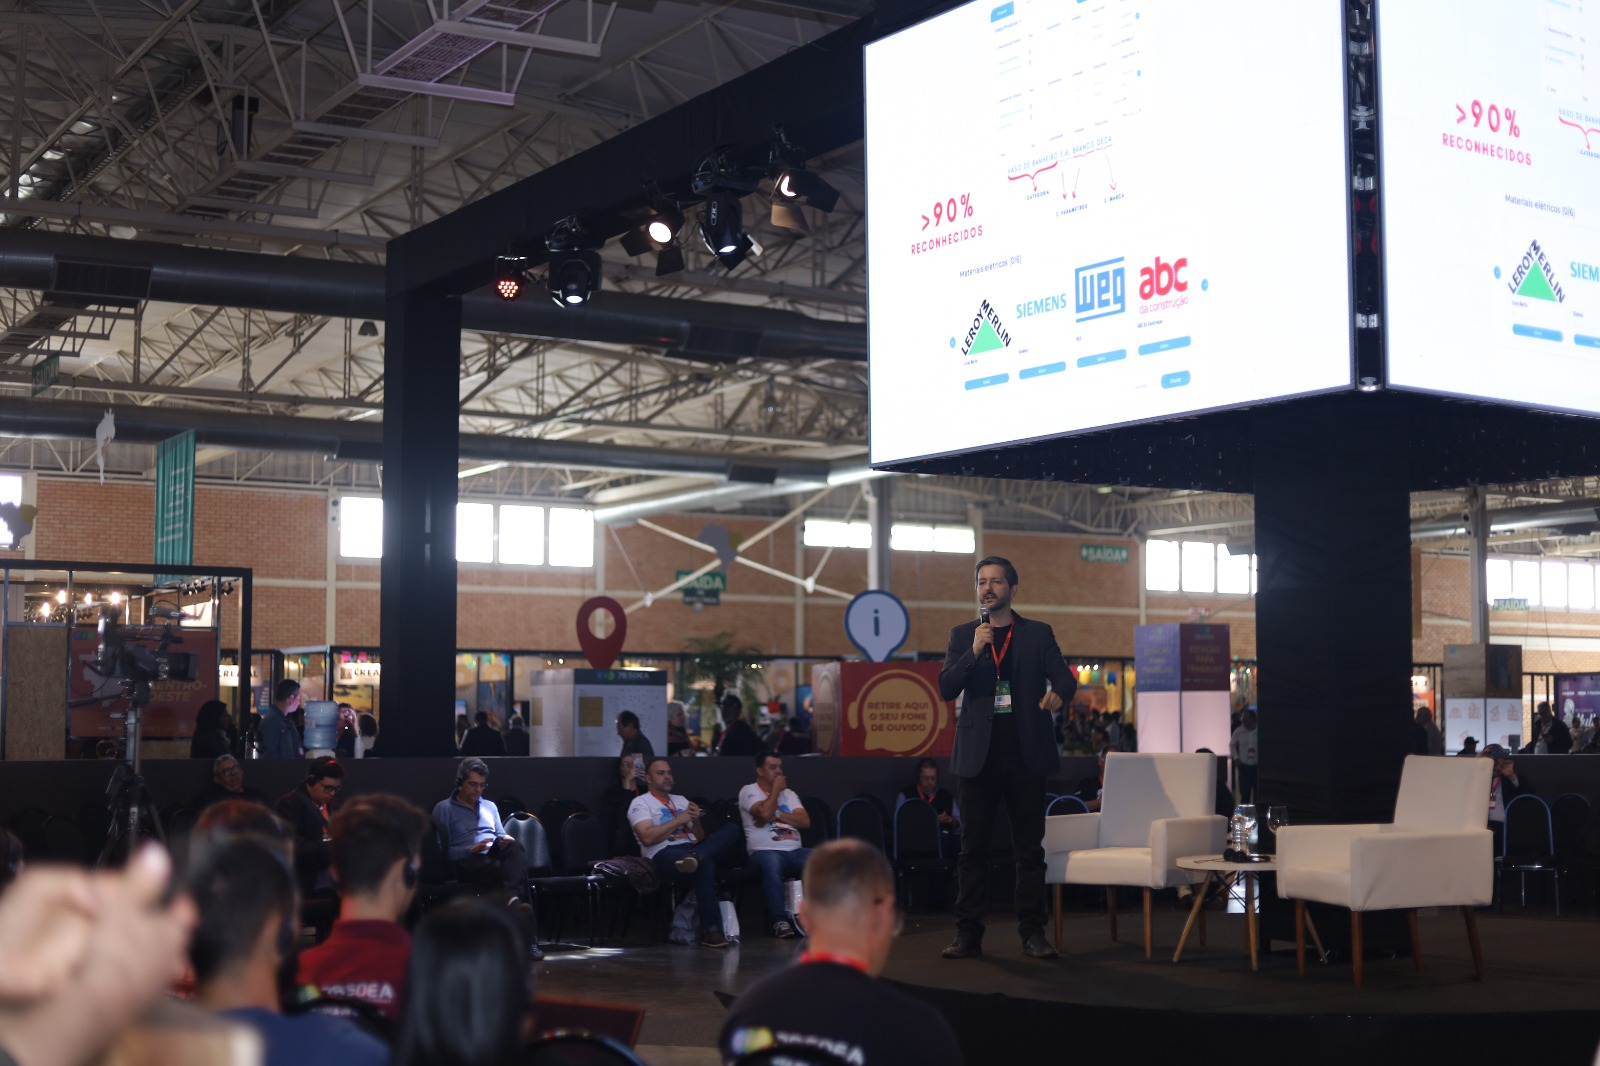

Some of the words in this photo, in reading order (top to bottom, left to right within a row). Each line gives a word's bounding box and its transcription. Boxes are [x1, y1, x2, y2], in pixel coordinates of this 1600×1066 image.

[1455, 98, 1521, 138] >90%
[1442, 132, 1532, 166] RECONHECIDOS
[921, 192, 973, 232] >90%
[1504, 193, 1533, 208] Materiais
[1534, 199, 1561, 214] elétricos
[911, 225, 983, 255] RECONHECIDOS
[960, 266, 984, 278] Materiais
[1138, 255, 1188, 301] abc
[1507, 246, 1534, 295] LEROY
[1531, 239, 1566, 304] MERLIN
[1016, 293, 1067, 319] SIEMENS
[1139, 304, 1149, 314] da
[1150, 295, 1189, 312] construção
[961, 308, 985, 356] LEROY
[981, 298, 1012, 348] MERLIN
[868, 701, 902, 710] RETIRE
[904, 701, 929, 711] AQUI
[869, 713, 877, 721] O
[879, 713, 898, 721] SEU
[901, 713, 927, 721] FONE
[871, 724, 884, 732] DE
[887, 723, 927, 732] OUVIDO
